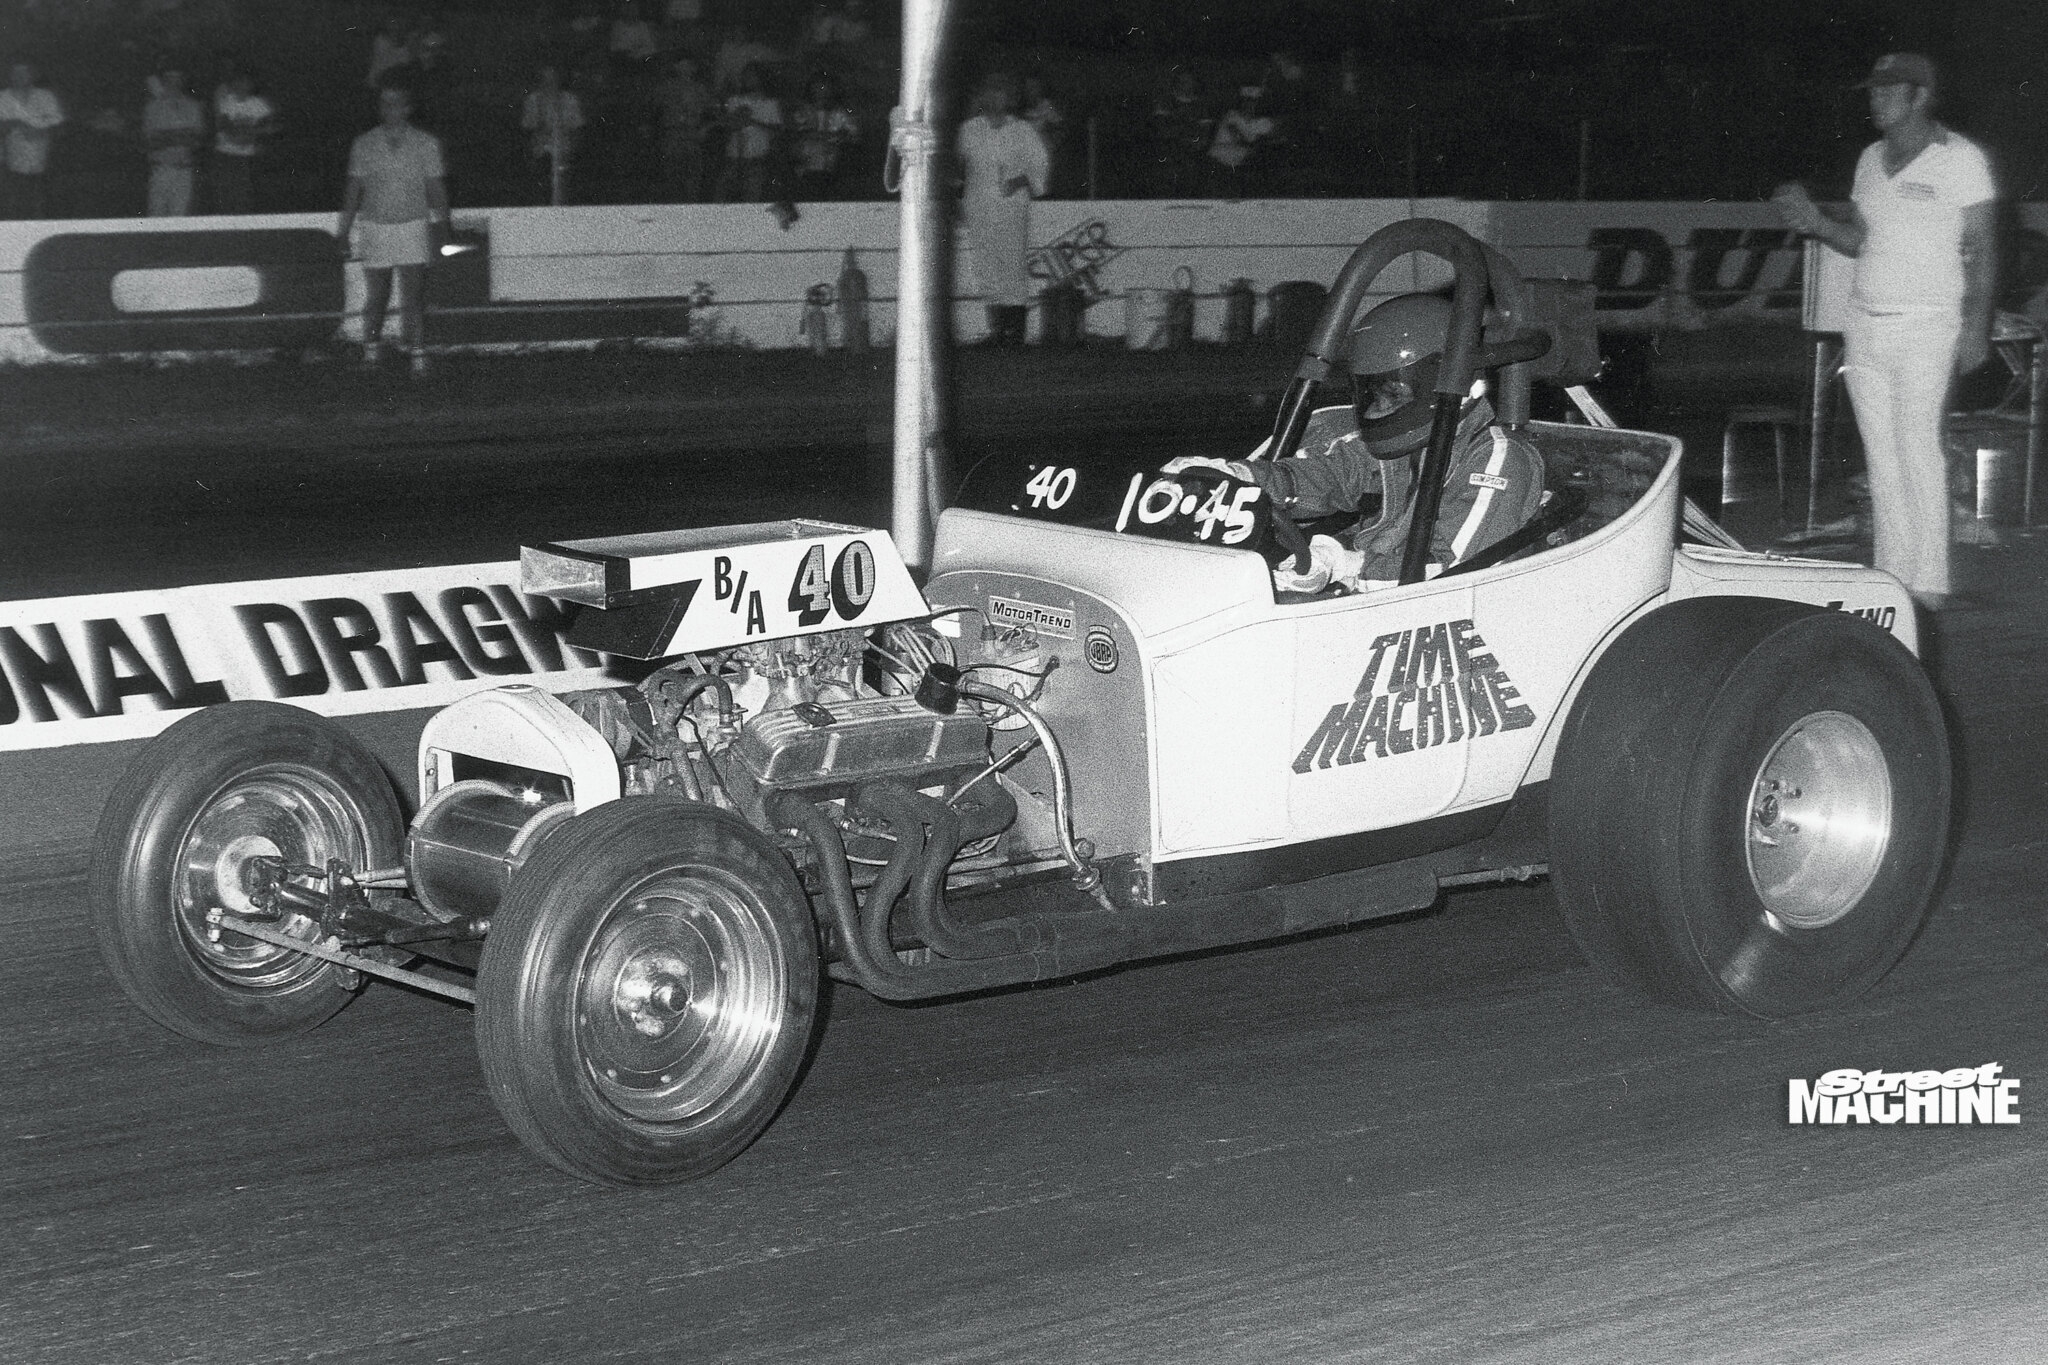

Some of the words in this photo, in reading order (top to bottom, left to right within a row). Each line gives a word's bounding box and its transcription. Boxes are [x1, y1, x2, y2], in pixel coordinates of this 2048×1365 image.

[1026, 465, 1077, 510] 40
[714, 555, 767, 636] B/A
[788, 539, 876, 628] 40
[0, 612, 229, 725] NAL
[1353, 618, 1500, 701] TIME
[1291, 670, 1537, 775] MACHINE
